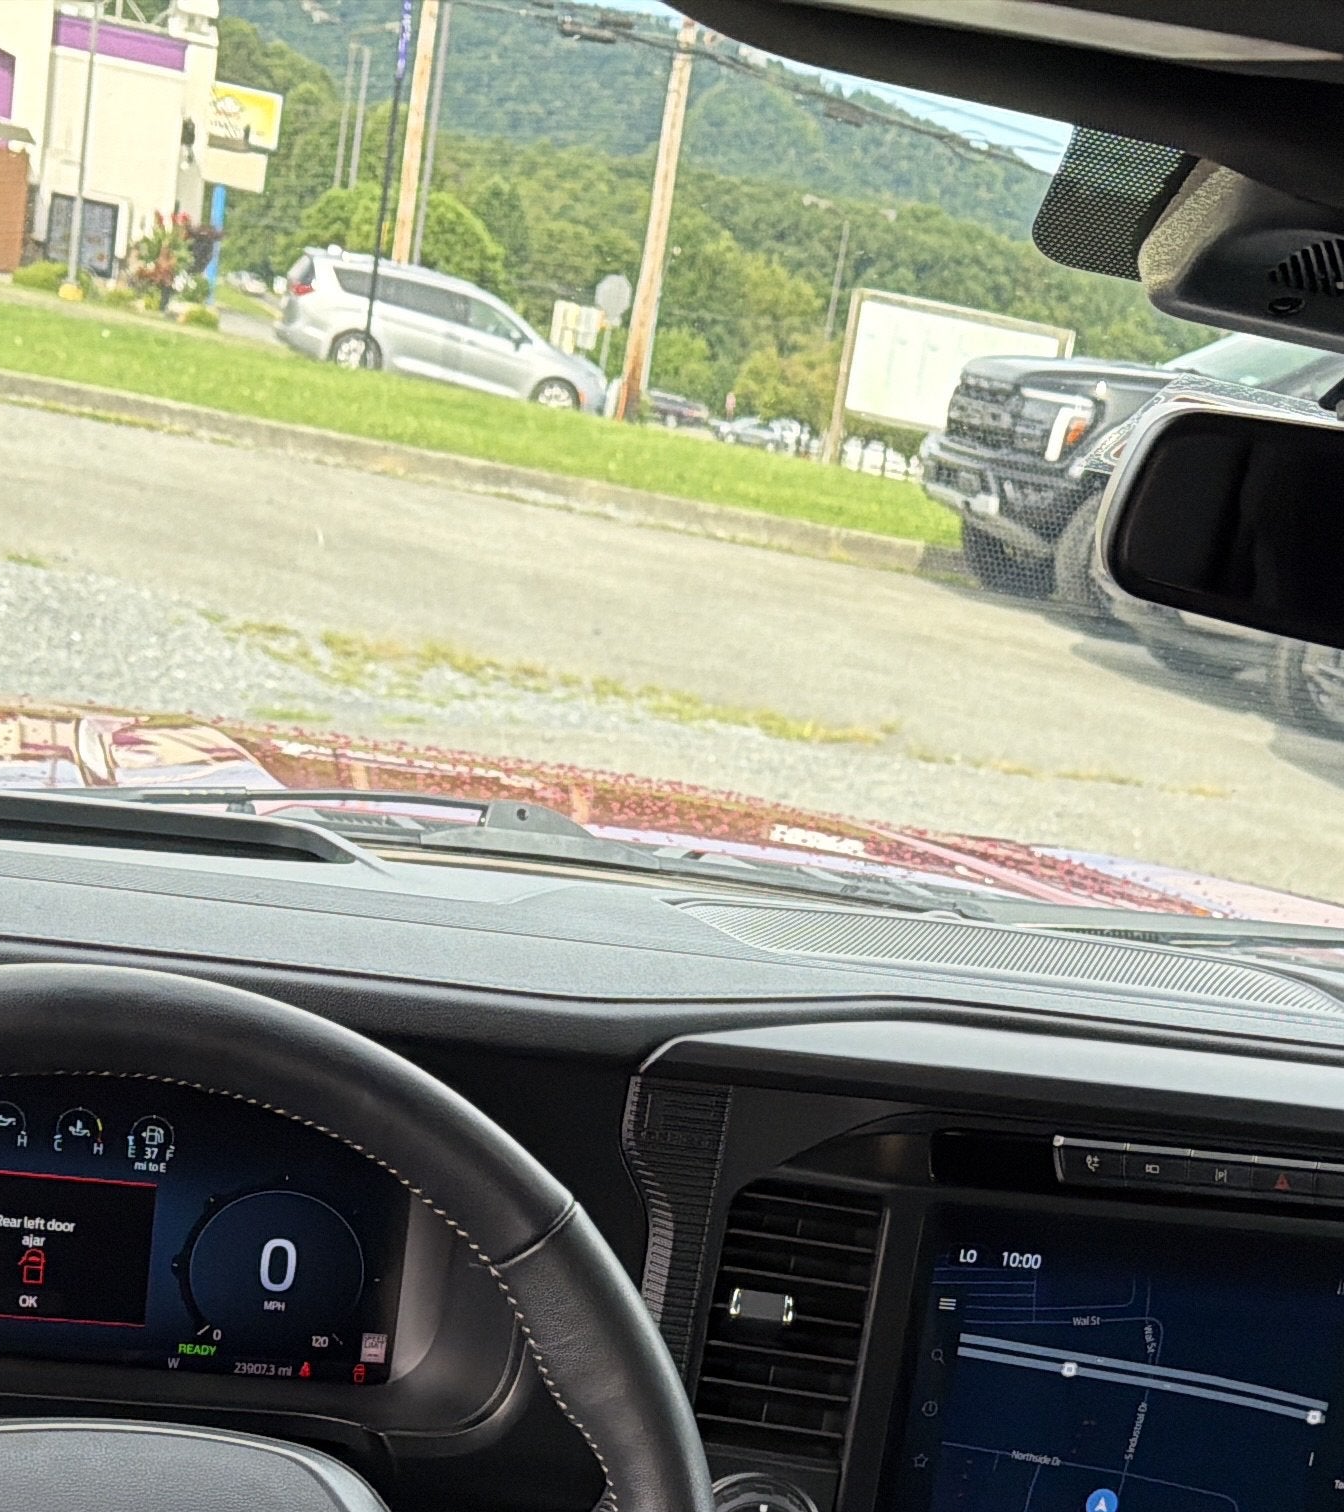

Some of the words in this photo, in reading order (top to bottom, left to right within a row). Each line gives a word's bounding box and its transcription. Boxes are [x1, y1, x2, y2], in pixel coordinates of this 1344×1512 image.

[144, 1148, 158, 1160] 37
[134, 1160, 147, 1171] mi
[148, 1162, 158, 1171] to
[24, 1217, 45, 1230] left
[46, 1218, 76, 1233] door
[22, 1234, 46, 1248] ajar
[959, 1249, 977, 1263] LO
[1002, 1251, 1042, 1269] 10:00
[260, 1238, 297, 1292] 0
[18, 1295, 38, 1308] OK
[264, 1301, 285, 1311] MPH
[213, 1329, 221, 1341] 0
[312, 1335, 329, 1348] 120
[178, 1343, 217, 1356] READY
[167, 1357, 180, 1368] W
